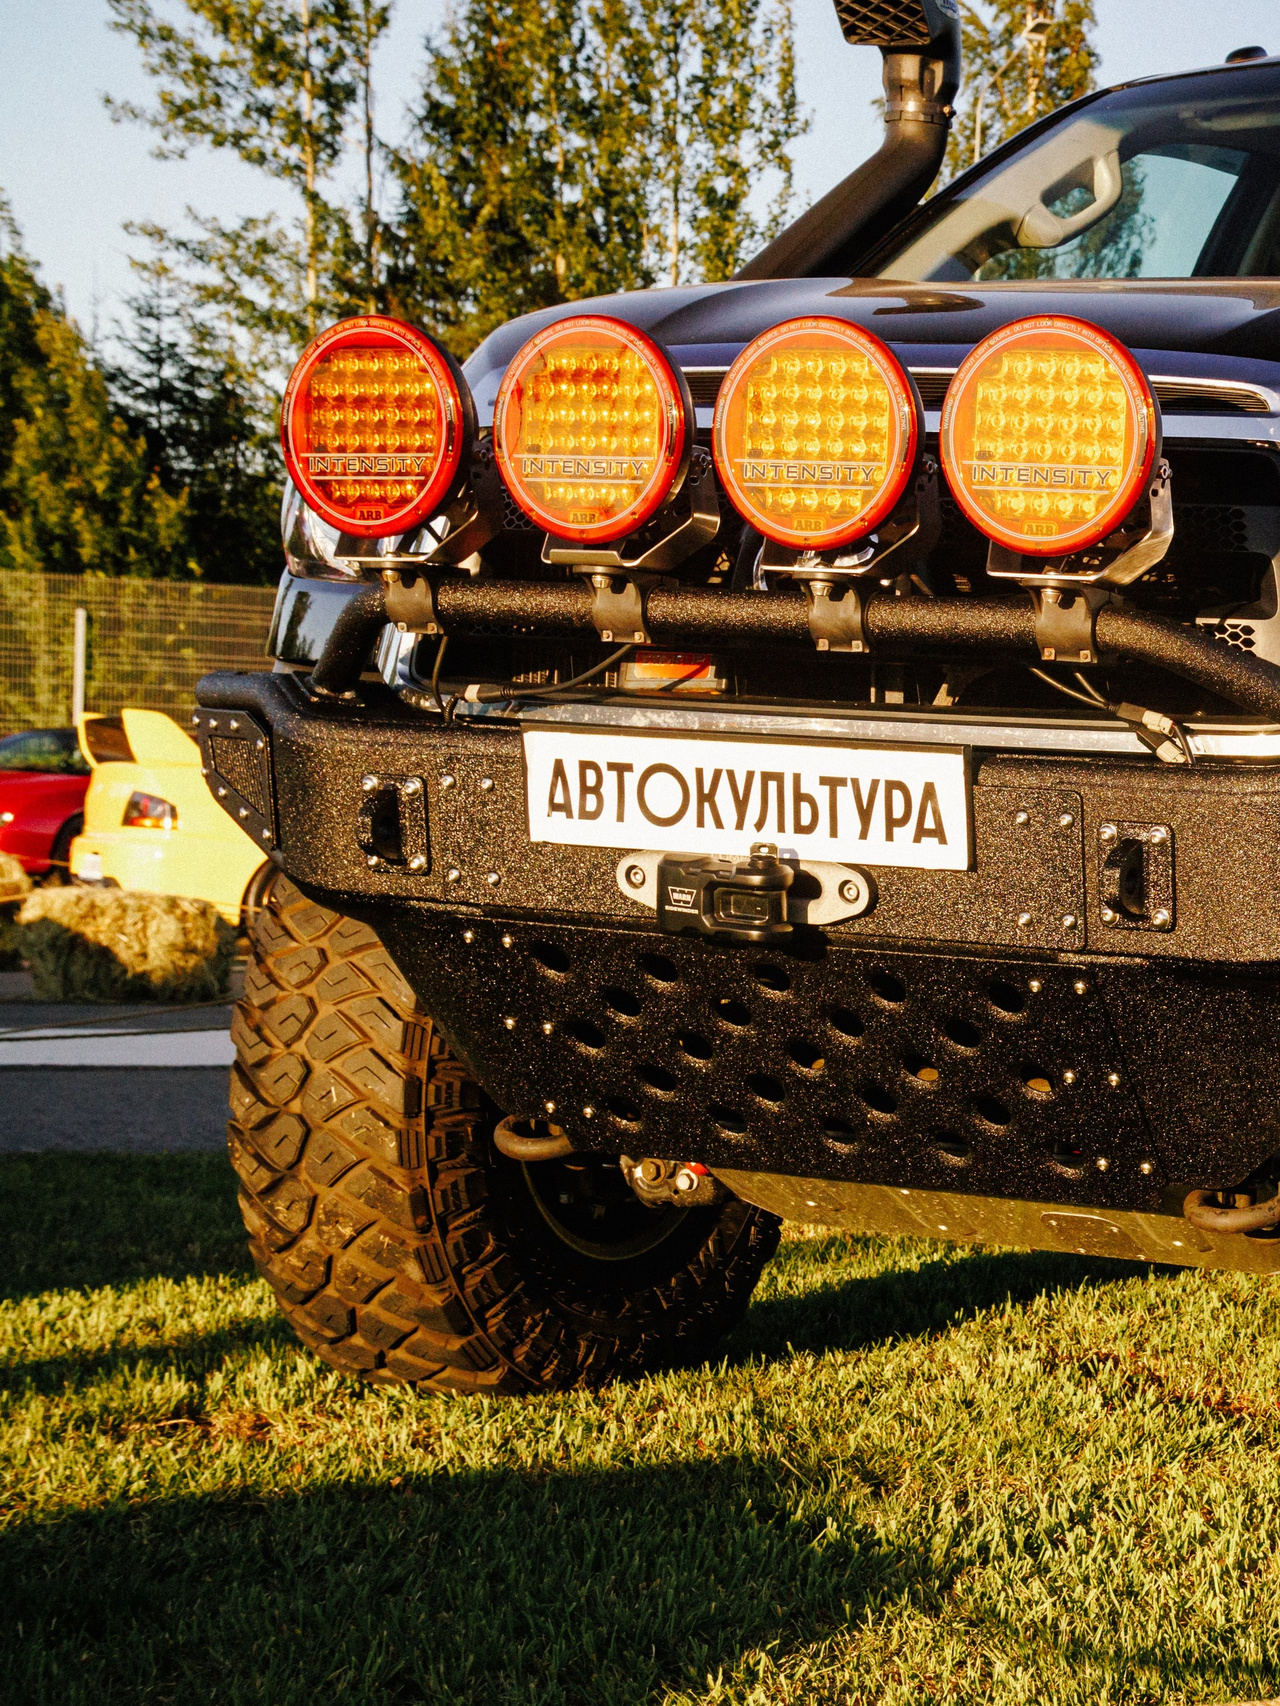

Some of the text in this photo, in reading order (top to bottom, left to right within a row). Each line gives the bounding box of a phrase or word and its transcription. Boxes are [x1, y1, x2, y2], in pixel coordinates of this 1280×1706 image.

[722, 379, 732, 395] HIGH
[728, 356, 745, 380] OUTPUT
[743, 343, 758, 359] LIGHT
[779, 325, 788, 333] DO
[788, 322, 801, 330] NOT
[818, 321, 845, 333] DIRECTLY
[844, 328, 857, 339] INTO
[857, 336, 875, 353] OPTICS
[873, 351, 888, 369] WHEN
[885, 367, 898, 386] LIGHT
[893, 385, 900, 393] IS
[950, 378, 961, 395] HIGH
[957, 356, 975, 380] OUTPUT
[973, 342, 990, 358] LIGHT
[1012, 324, 1022, 332] DO
[1022, 321, 1035, 329] NOT
[1053, 320, 1081, 333] DIRECTLY
[1081, 328, 1095, 340] INTO
[1094, 335, 1114, 354] OPTICS
[1111, 351, 1127, 371] WHEN
[1123, 369, 1136, 388] LIGHT
[1132, 387, 1139, 396] IS
[308, 457, 426, 473] INTENSITY
[522, 458, 645, 476] INTENSITY
[743, 463, 876, 482] INTENSITY
[972, 465, 1111, 486] INTENSITY
[358, 510, 382, 520] ARB
[571, 513, 597, 523] ARB
[795, 520, 822, 531] ARB
[1025, 525, 1054, 536] ARB
[546, 758, 949, 846] АВТОКУЛЬТУРА
[672, 892, 691, 901] WARN
